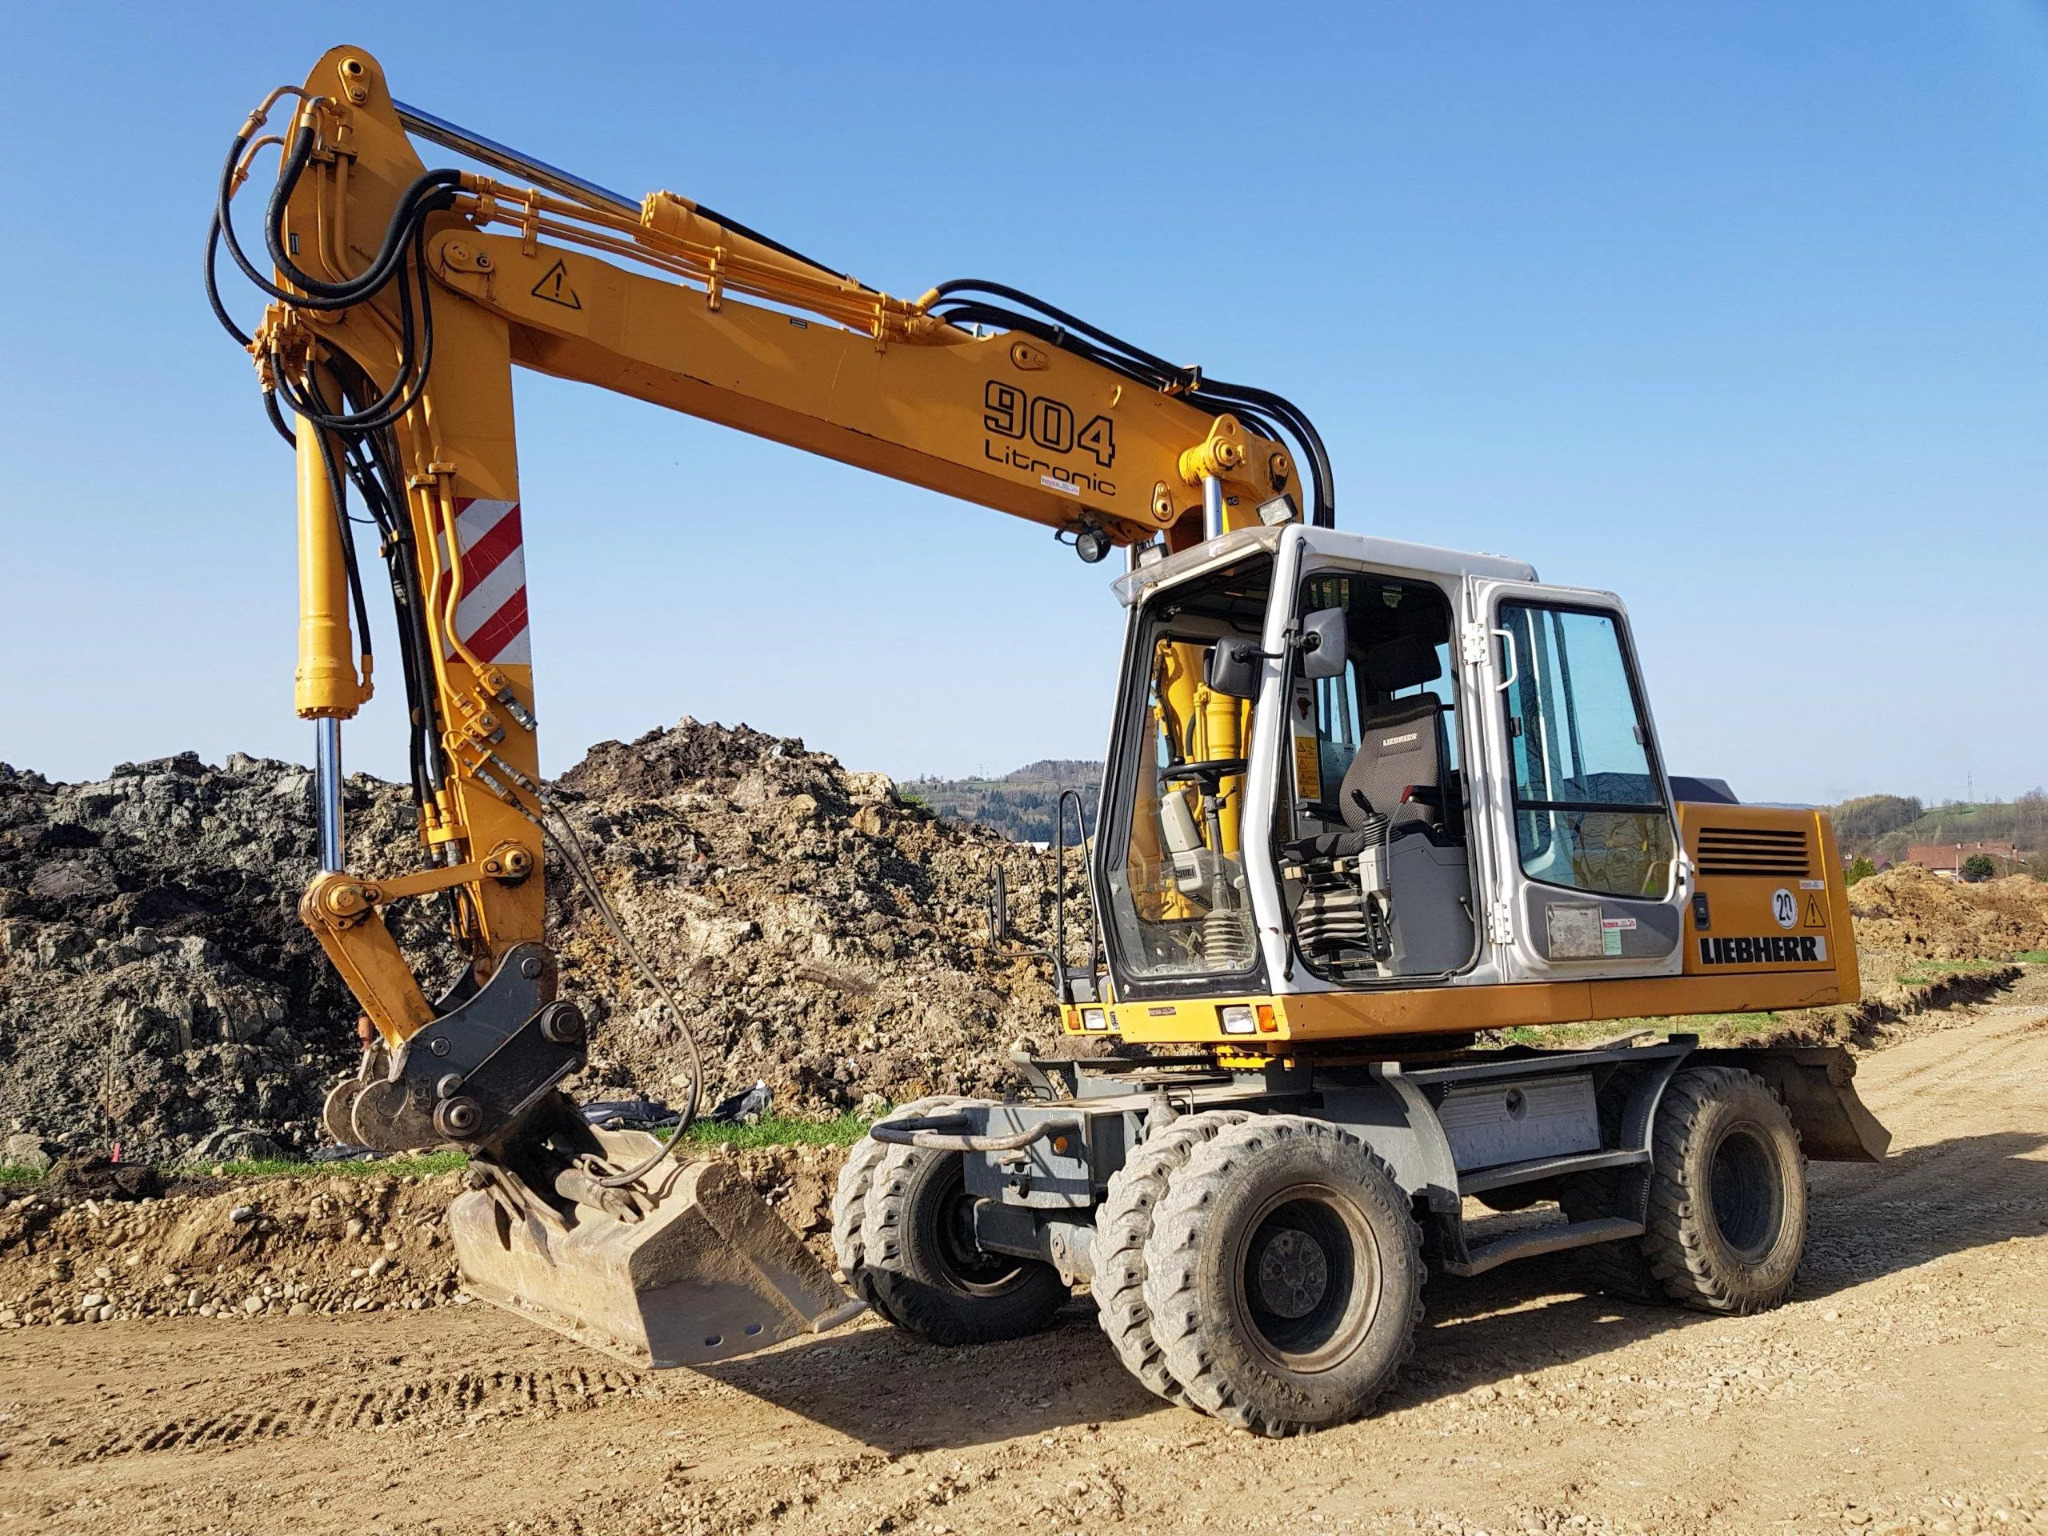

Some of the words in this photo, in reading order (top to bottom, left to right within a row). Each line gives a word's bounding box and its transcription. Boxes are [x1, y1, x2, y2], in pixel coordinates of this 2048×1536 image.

[984, 379, 1116, 469] 904
[985, 438, 1116, 496] Litronic
[1776, 893, 1793, 921] 20
[1700, 936, 1818, 964] LIEBHERR
